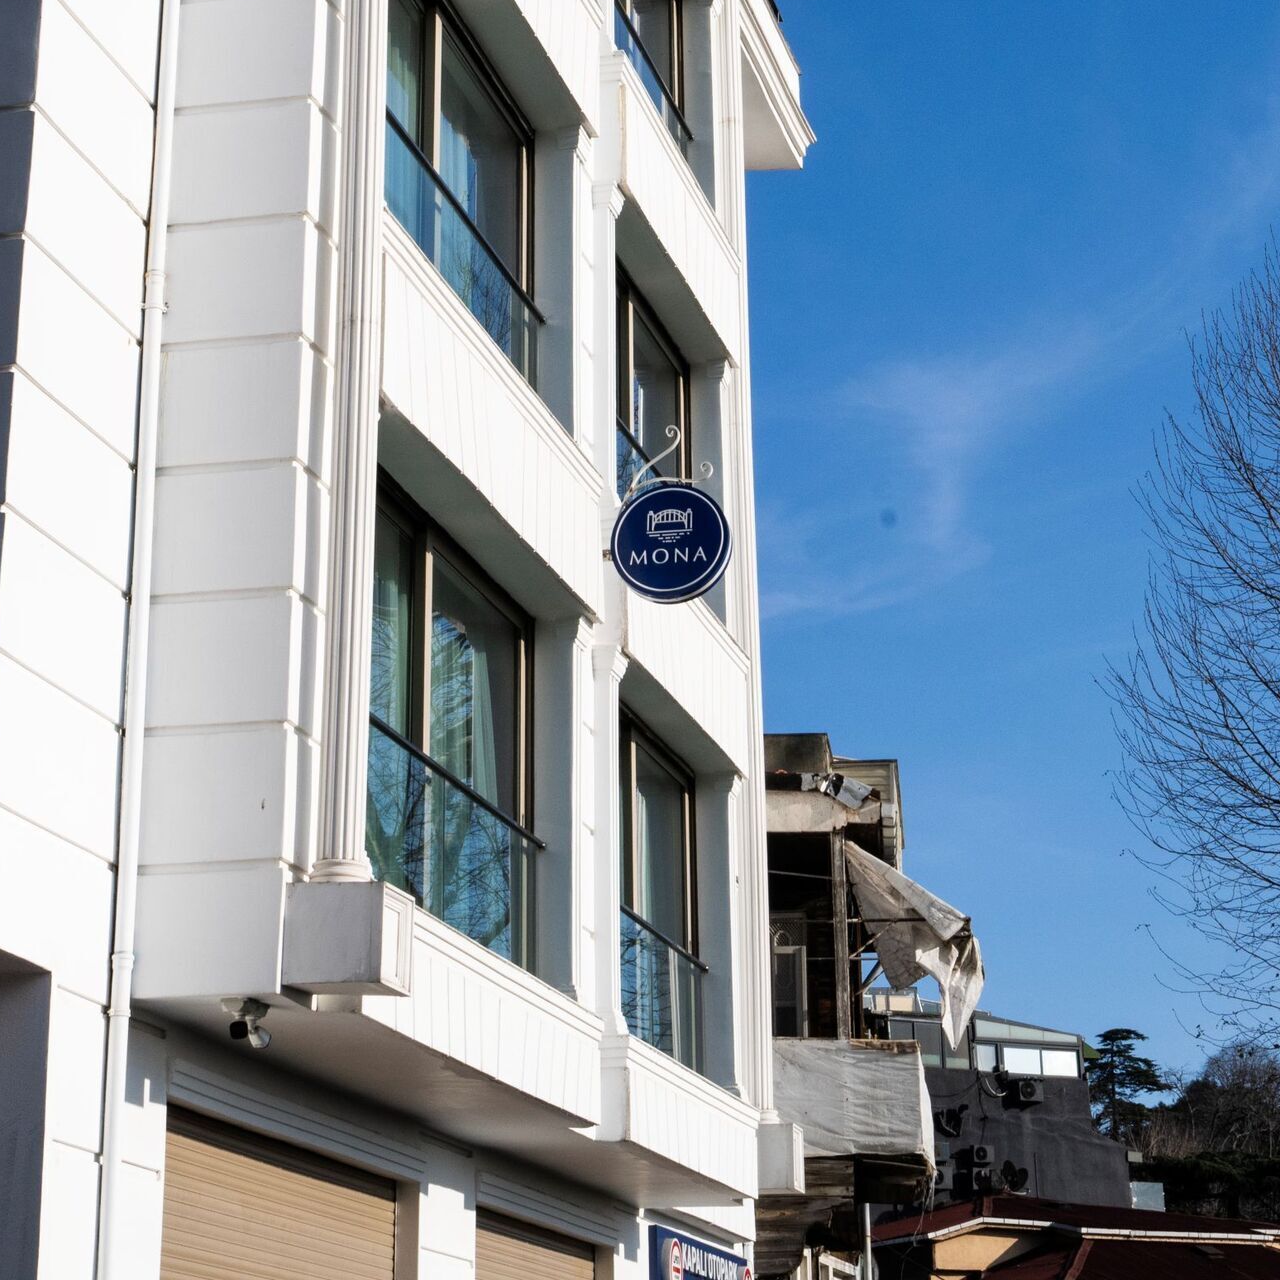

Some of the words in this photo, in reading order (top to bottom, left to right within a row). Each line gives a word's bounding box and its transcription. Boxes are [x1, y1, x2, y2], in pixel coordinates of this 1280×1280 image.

[629, 546, 707, 566] MONA
[681, 1242, 708, 1278] KAPALI
[707, 1252, 738, 1280] OTOPARK
